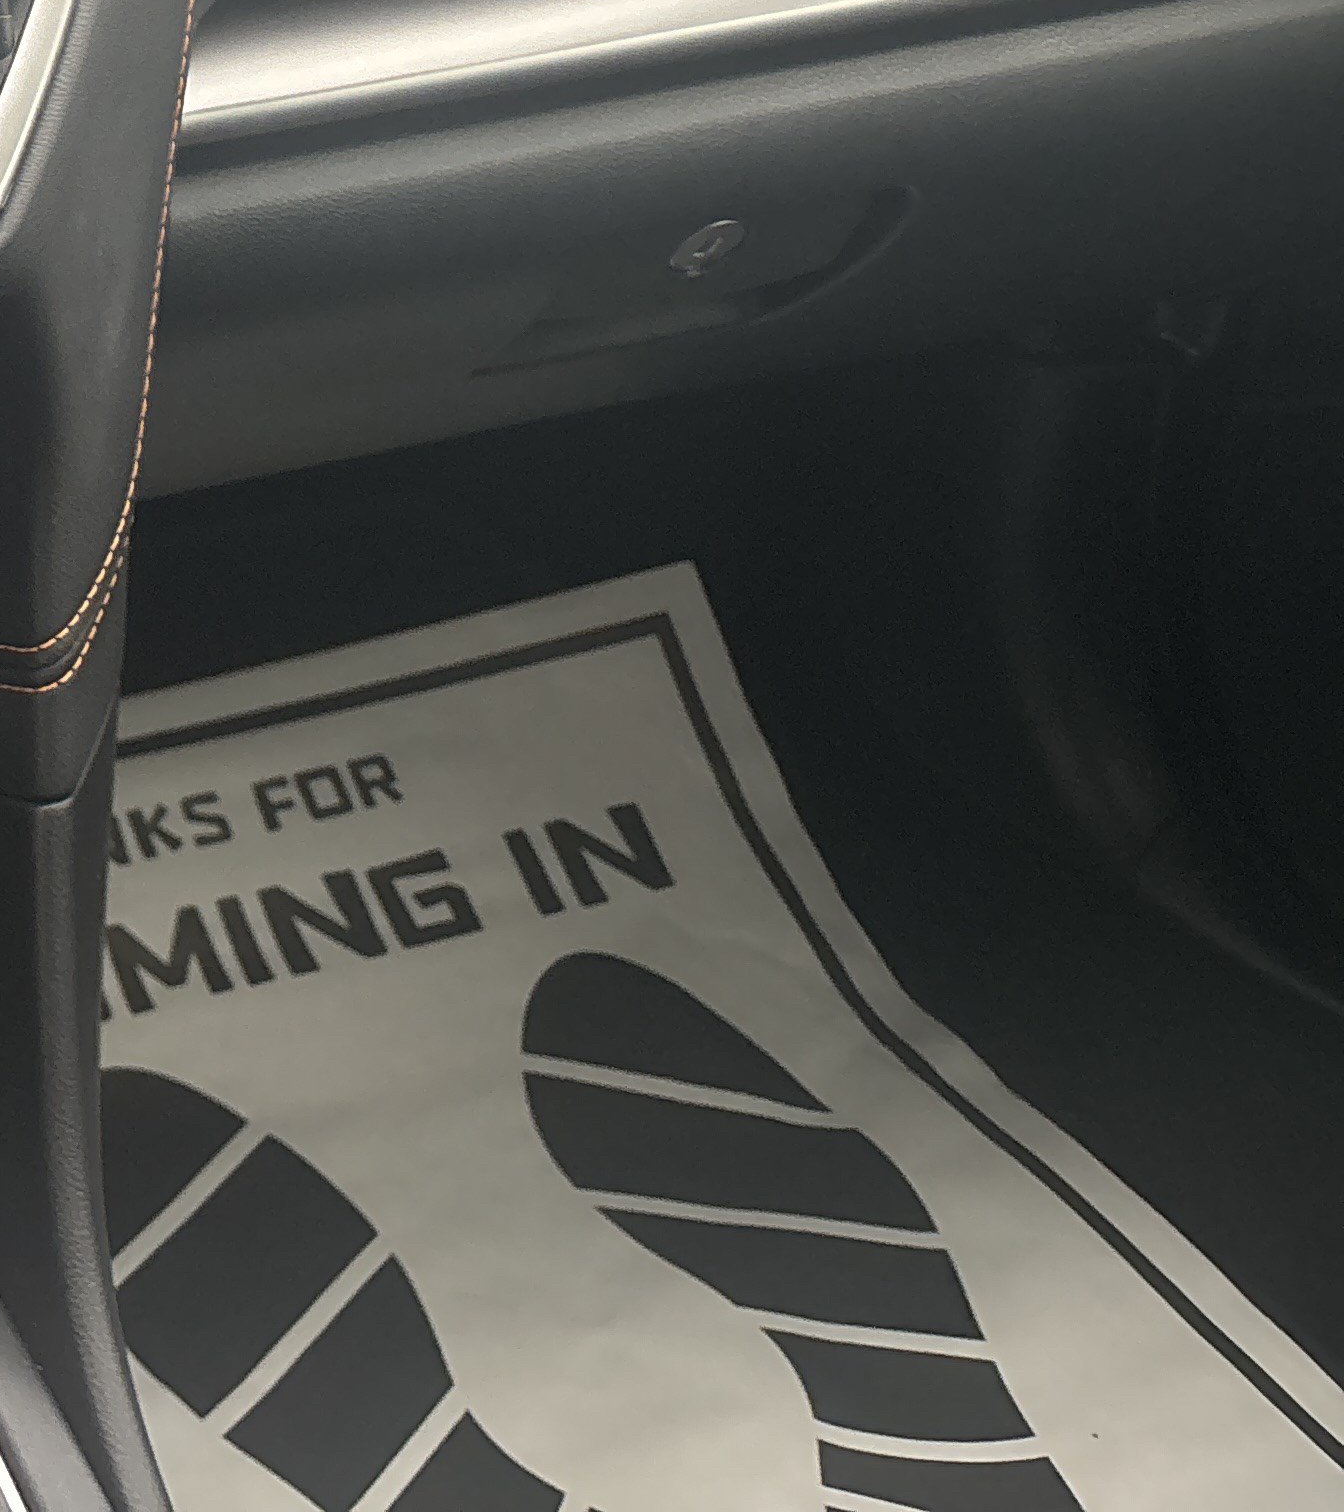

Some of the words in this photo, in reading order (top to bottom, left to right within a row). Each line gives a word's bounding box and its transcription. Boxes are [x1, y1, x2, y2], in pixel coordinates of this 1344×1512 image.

[250, 752, 405, 834] FOR
[100, 847, 485, 1021] MING
[501, 800, 678, 917] IN
